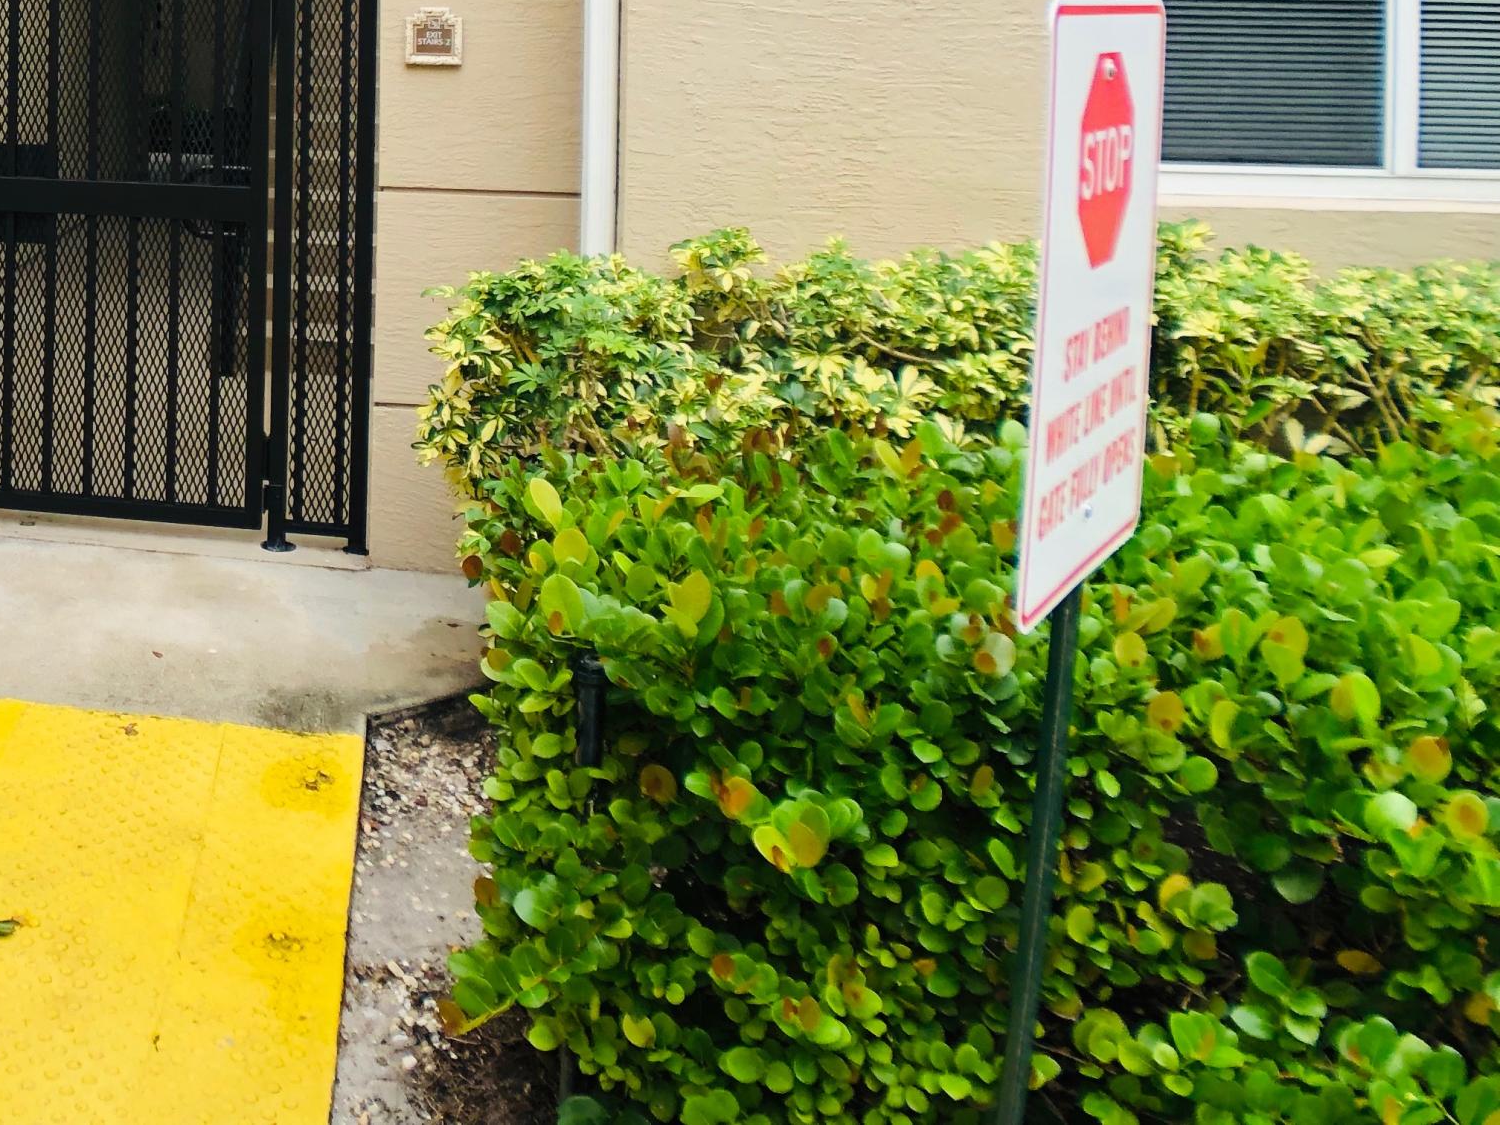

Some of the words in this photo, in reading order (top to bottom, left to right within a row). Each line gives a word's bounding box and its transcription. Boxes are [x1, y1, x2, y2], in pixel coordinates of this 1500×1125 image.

[417, 38, 444, 46] STAIRS
[426, 31, 443, 39] EXIT
[1081, 124, 1132, 201] STOP
[1063, 326, 1091, 383] STAY
[1093, 305, 1130, 364] BEHIND
[1046, 401, 1081, 467] WHITE
[1083, 383, 1108, 437] LINE
[1110, 364, 1137, 417] UNTIL
[1037, 479, 1067, 542] GATE
